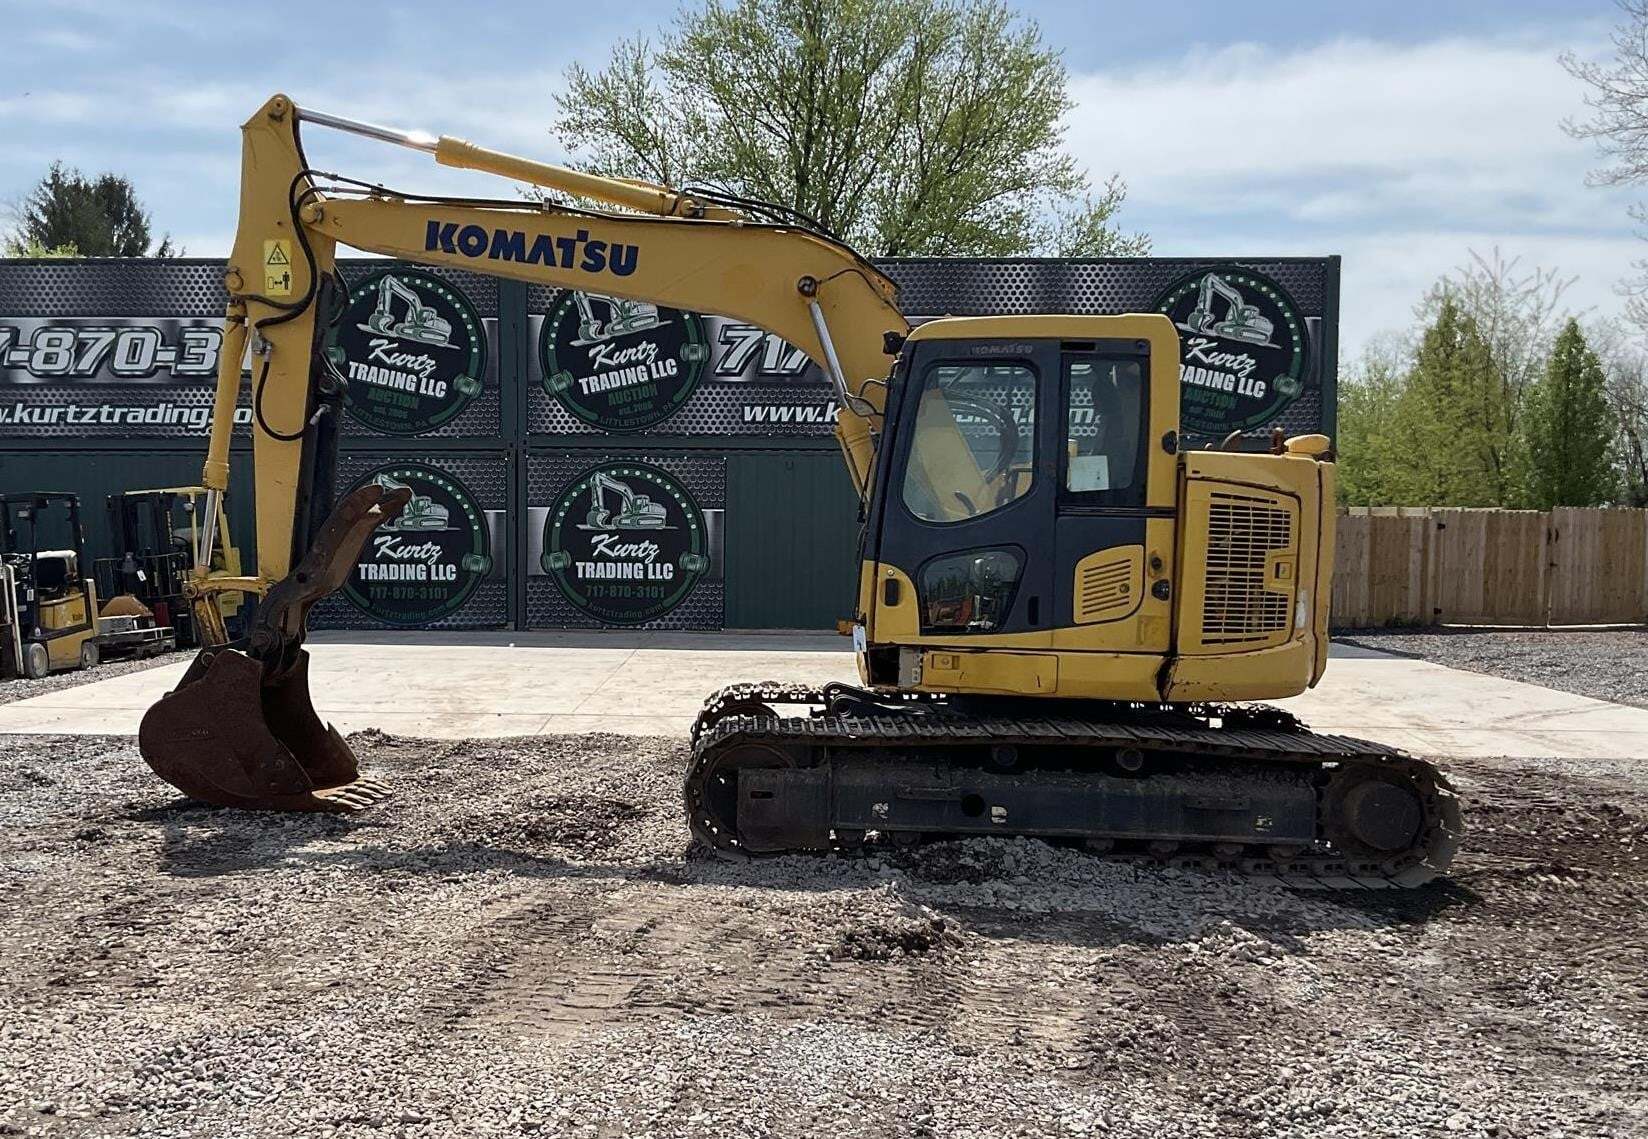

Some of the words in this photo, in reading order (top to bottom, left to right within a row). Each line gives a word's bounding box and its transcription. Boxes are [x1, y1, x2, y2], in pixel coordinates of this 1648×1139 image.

[425, 220, 639, 276] KOMATSU
[368, 338, 437, 378] Kurtz
[588, 340, 659, 370] Kurtz
[1185, 337, 1257, 378] Kurtz
[349, 361, 417, 392] TRADING
[419, 376, 447, 398] LLC
[578, 364, 649, 395] TRADING
[650, 358, 678, 379] LLC
[1237, 376, 1266, 398] LLC
[608, 383, 658, 407] AUCTION
[373, 535, 443, 565] Kurtz
[590, 533, 661, 564] Kurtz
[358, 563, 427, 581] TRADING
[430, 563, 457, 581] LLC
[575, 561, 644, 579] TRADING
[647, 562, 674, 580] LLC
[586, 585, 665, 598] 717-870-3101
